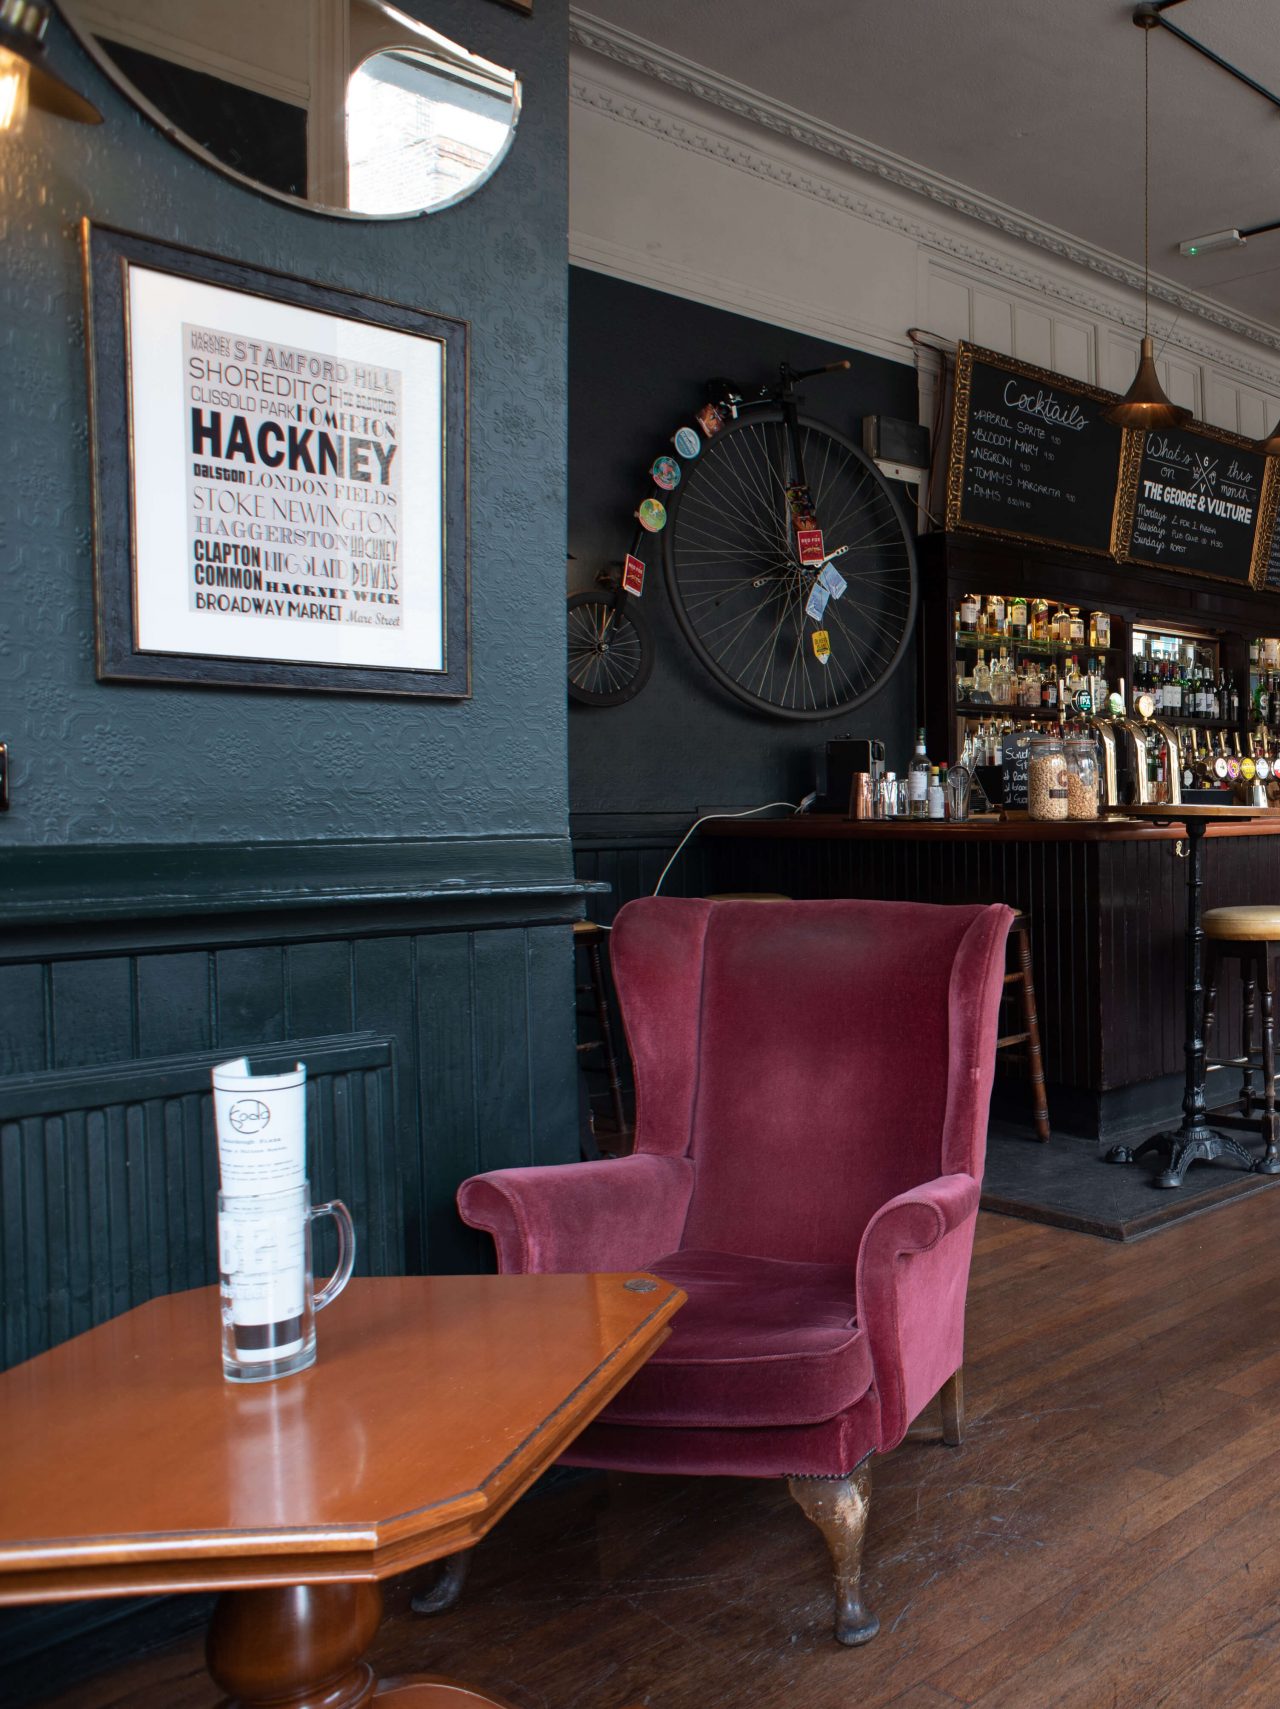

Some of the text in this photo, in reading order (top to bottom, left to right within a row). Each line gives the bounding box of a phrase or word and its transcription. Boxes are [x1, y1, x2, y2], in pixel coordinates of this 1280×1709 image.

[234, 340, 394, 394] STAMFORD HILL
[189, 357, 342, 408] SHOREDITCH
[191, 385, 295, 420] CLISSOLD PARK
[1003, 380, 1090, 427] Cocktails
[297, 403, 397, 440] HOMERTON
[192, 407, 398, 486] HACKNEY
[974, 428, 1011, 449] BLOODY
[1015, 439, 1039, 456] MARY
[1146, 433, 1192, 465] What's
[973, 447, 1013, 468] NEGRONI
[1226, 459, 1253, 482] this
[1160, 466, 1175, 480] on
[248, 470, 397, 507] LONDON FIELDS
[1143, 480, 1162, 501] THE
[1163, 486, 1196, 510] GEORGE
[1197, 496, 1206, 512] &
[1207, 497, 1253, 525] VULTURE
[1220, 484, 1250, 502] month
[193, 486, 398, 535] STOKE NEWINGTON
[193, 515, 350, 551] HAGGERSTON
[350, 535, 398, 561] HACKNEY
[1133, 531, 1165, 555] Sundays
[193, 539, 261, 568] CLAPTON
[193, 563, 263, 591] COMMON
[196, 591, 342, 621] BROADWAY MARKET
[265, 581, 400, 605] HACKNEY WICK
[346, 609, 400, 626] Mare Street
